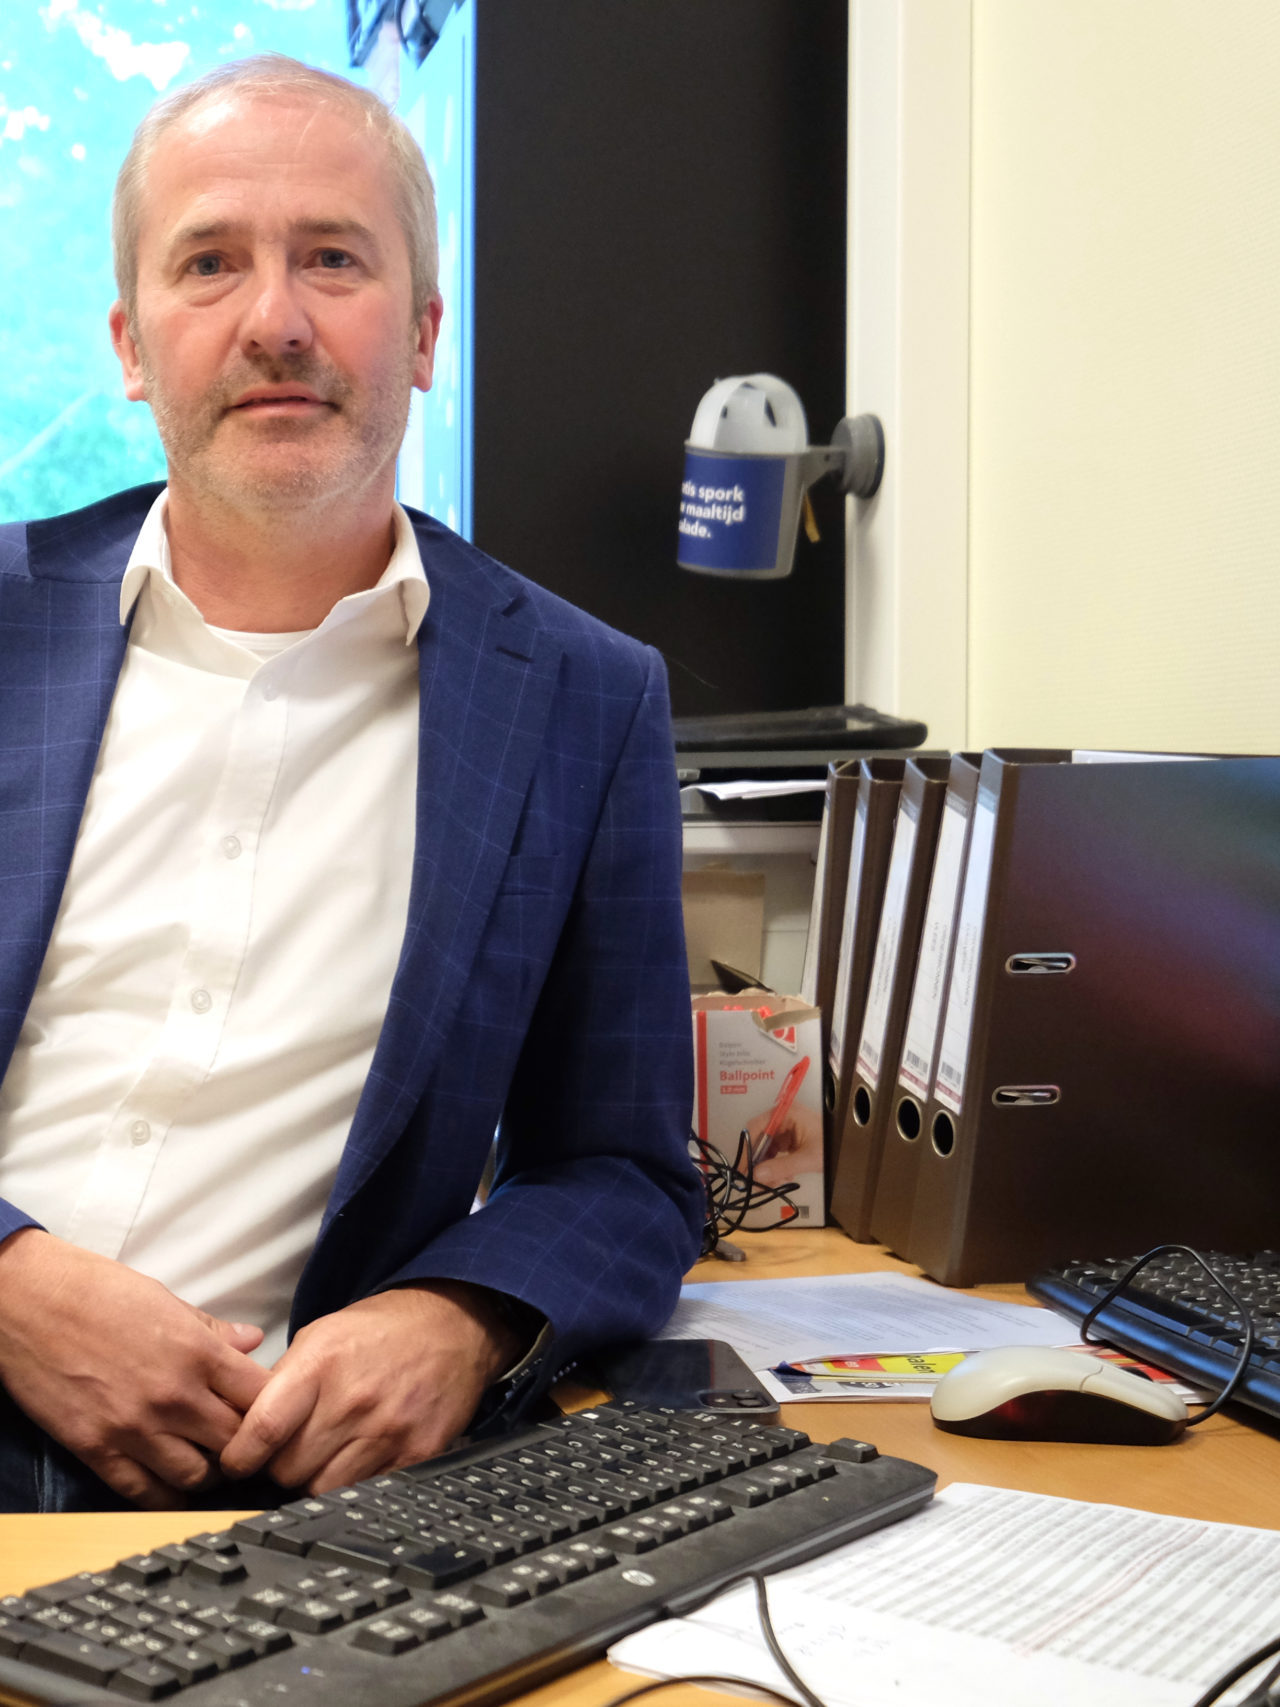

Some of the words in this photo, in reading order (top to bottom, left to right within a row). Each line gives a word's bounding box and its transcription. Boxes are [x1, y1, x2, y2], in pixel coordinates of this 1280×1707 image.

[698, 485, 744, 503] spork
[686, 503, 745, 526] maaltijd
[719, 1069, 776, 1084] Ballpoint
[906, 1355, 936, 1374] alen
